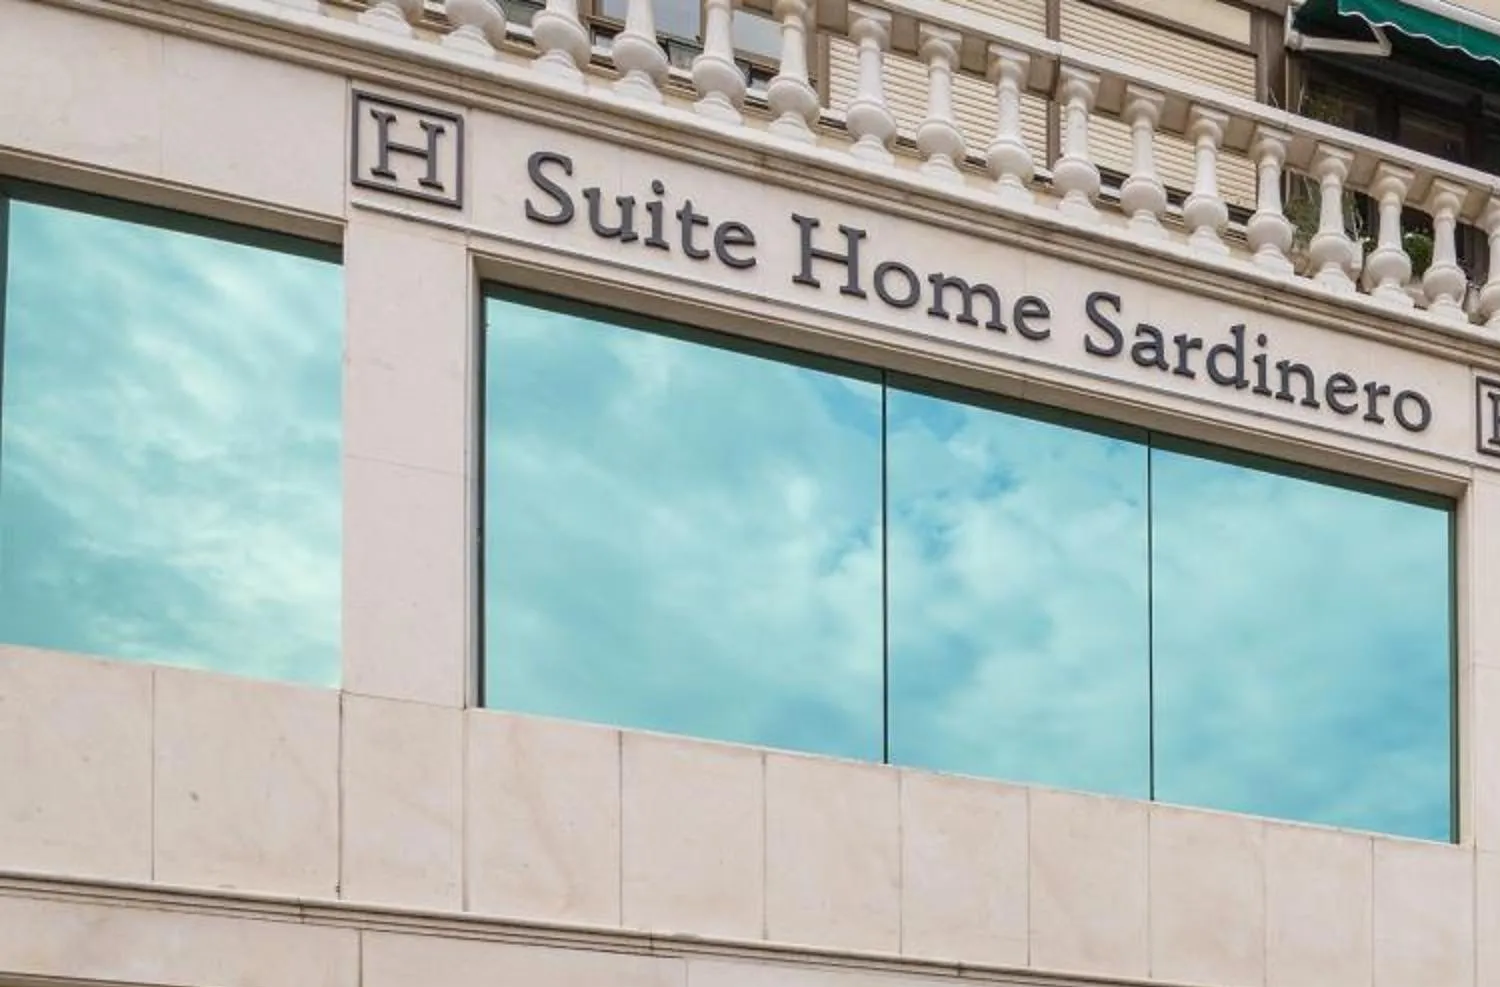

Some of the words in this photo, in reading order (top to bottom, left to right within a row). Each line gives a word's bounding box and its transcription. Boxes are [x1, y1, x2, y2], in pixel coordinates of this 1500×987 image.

[371, 108, 445, 191] H
[525, 150, 757, 269] Suite
[791, 212, 1052, 341] Home
[1084, 290, 1431, 432] Sardinero
